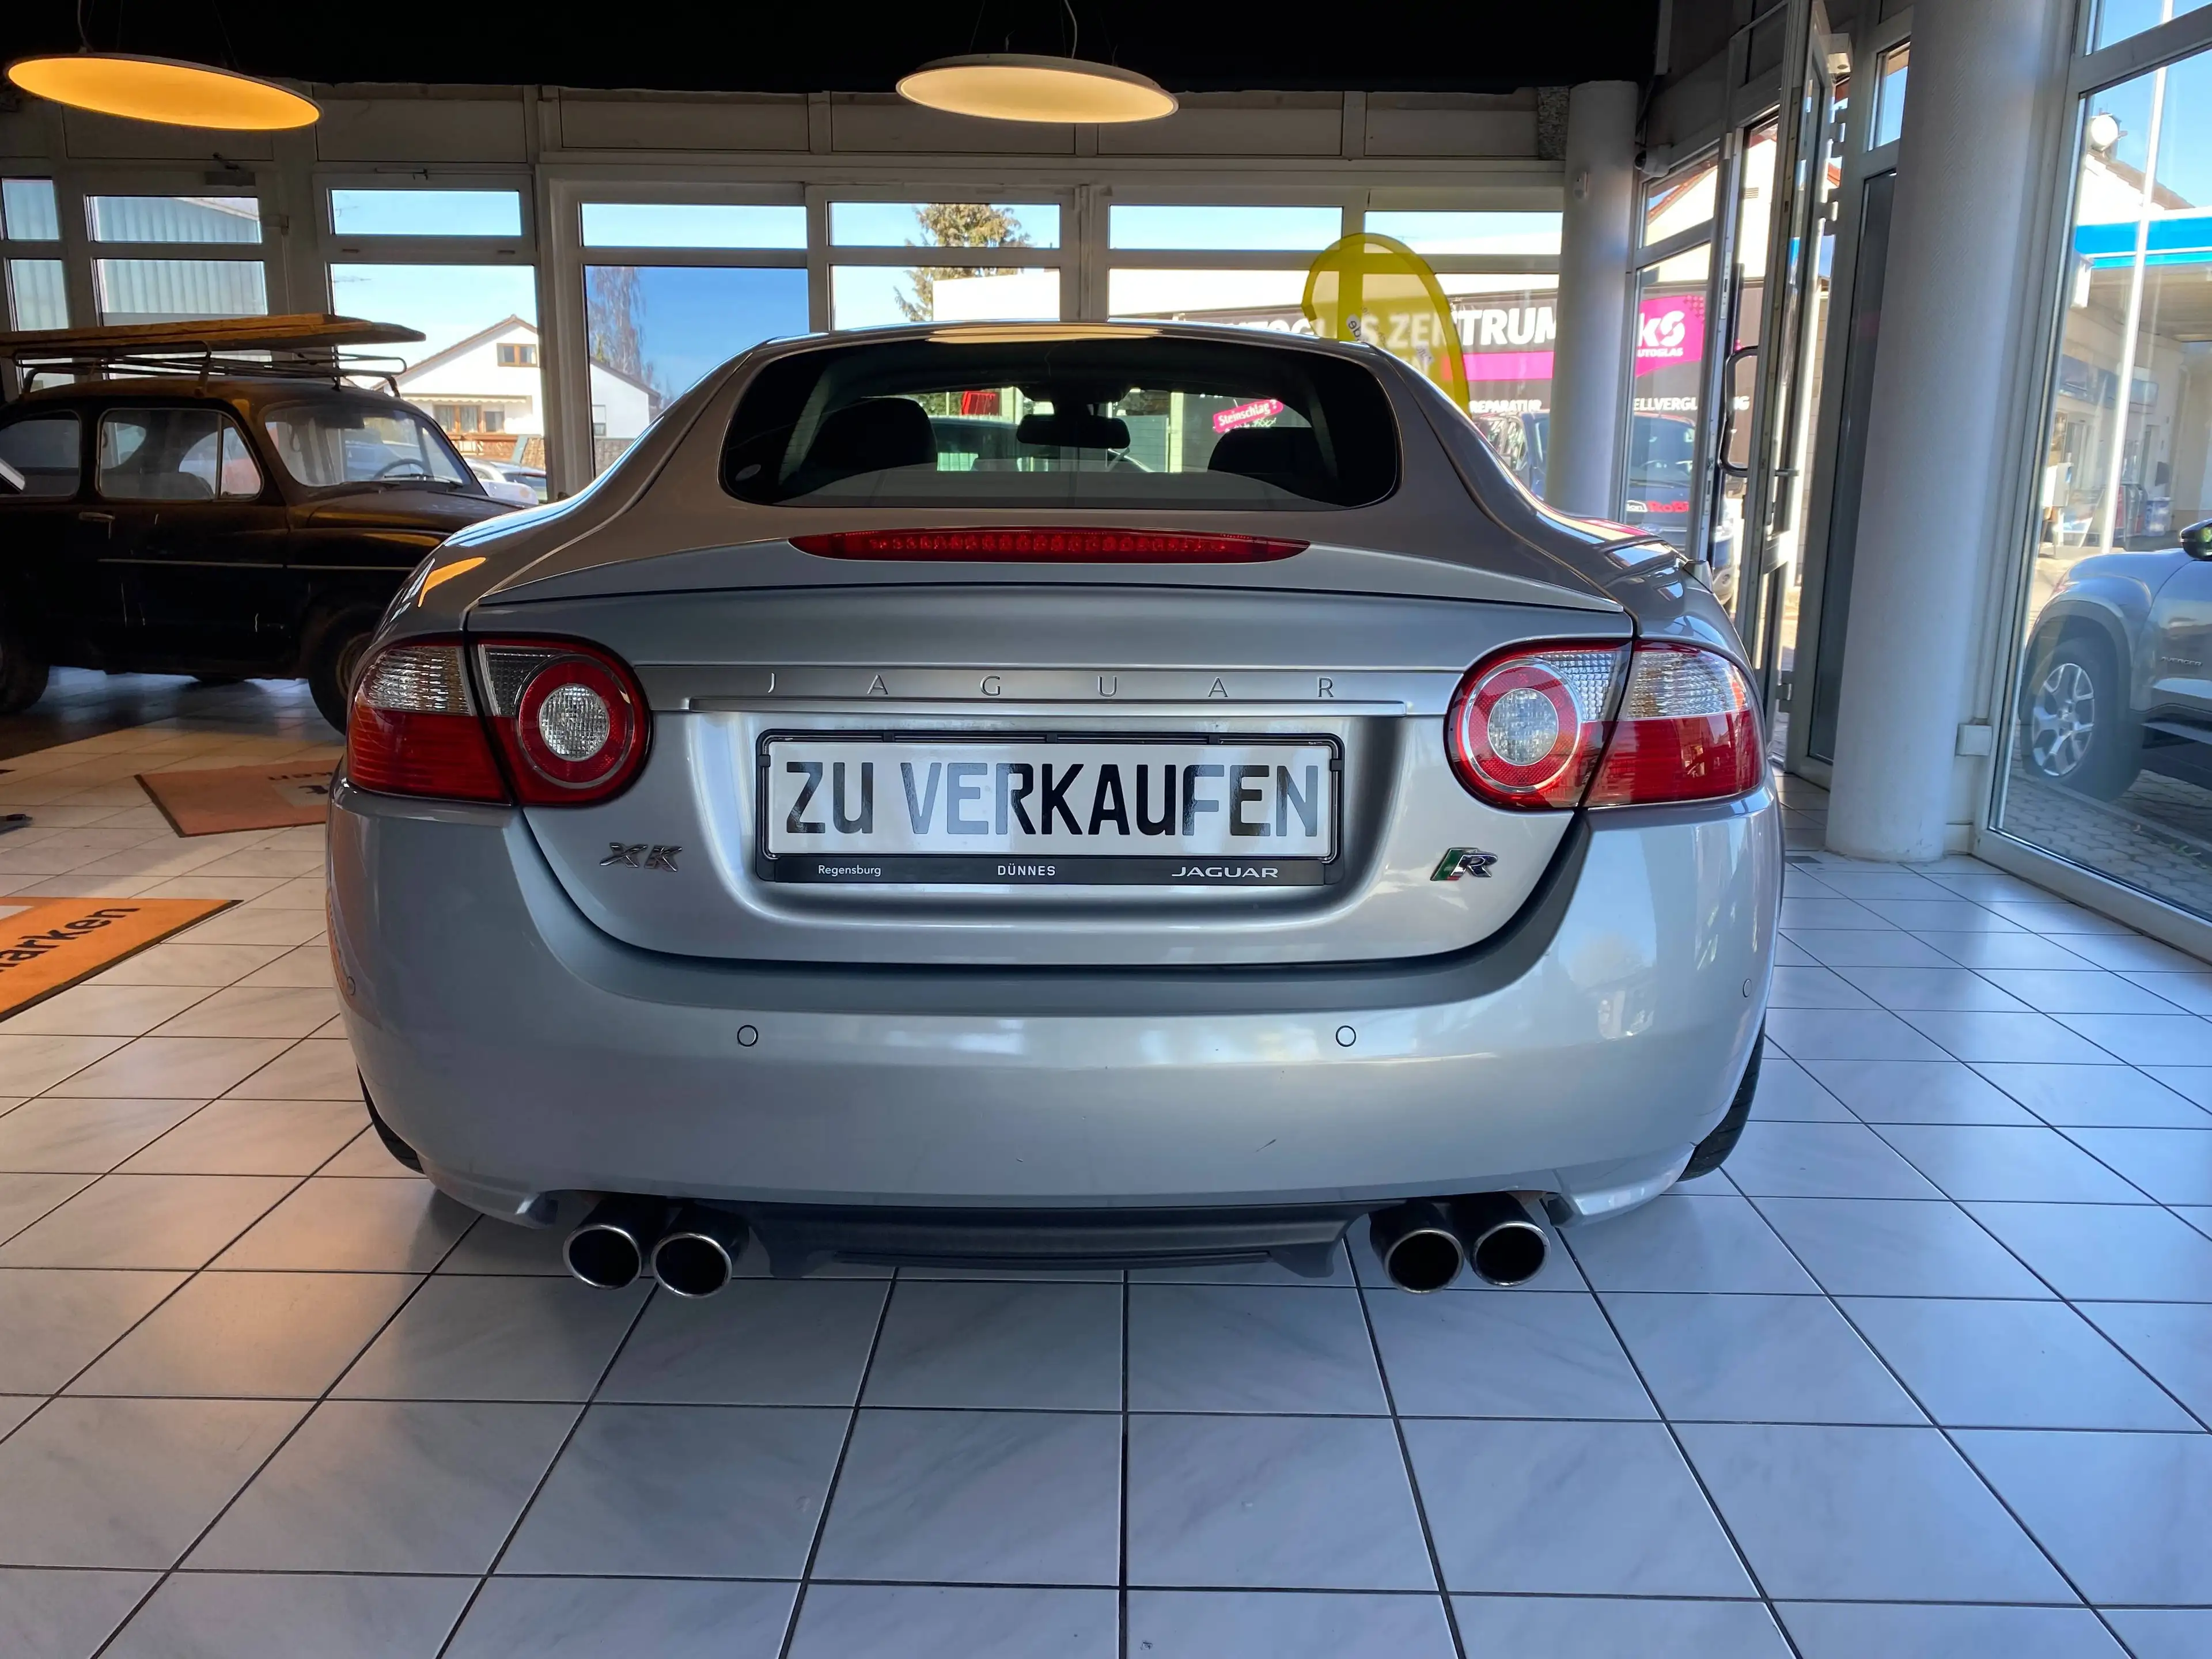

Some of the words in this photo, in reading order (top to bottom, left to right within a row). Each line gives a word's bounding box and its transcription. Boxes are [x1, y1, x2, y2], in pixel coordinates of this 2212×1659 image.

[1637, 347, 1684, 357] UTOGLAS
[1218, 403, 1271, 426] Steinschlag
[786, 762, 873, 834] ZU
[900, 762, 1319, 837] VERKAUFEN
[818, 865, 881, 877] Regensburg
[998, 863, 1056, 876] DÜNNES
[1171, 867, 1279, 878] JAGUAR
